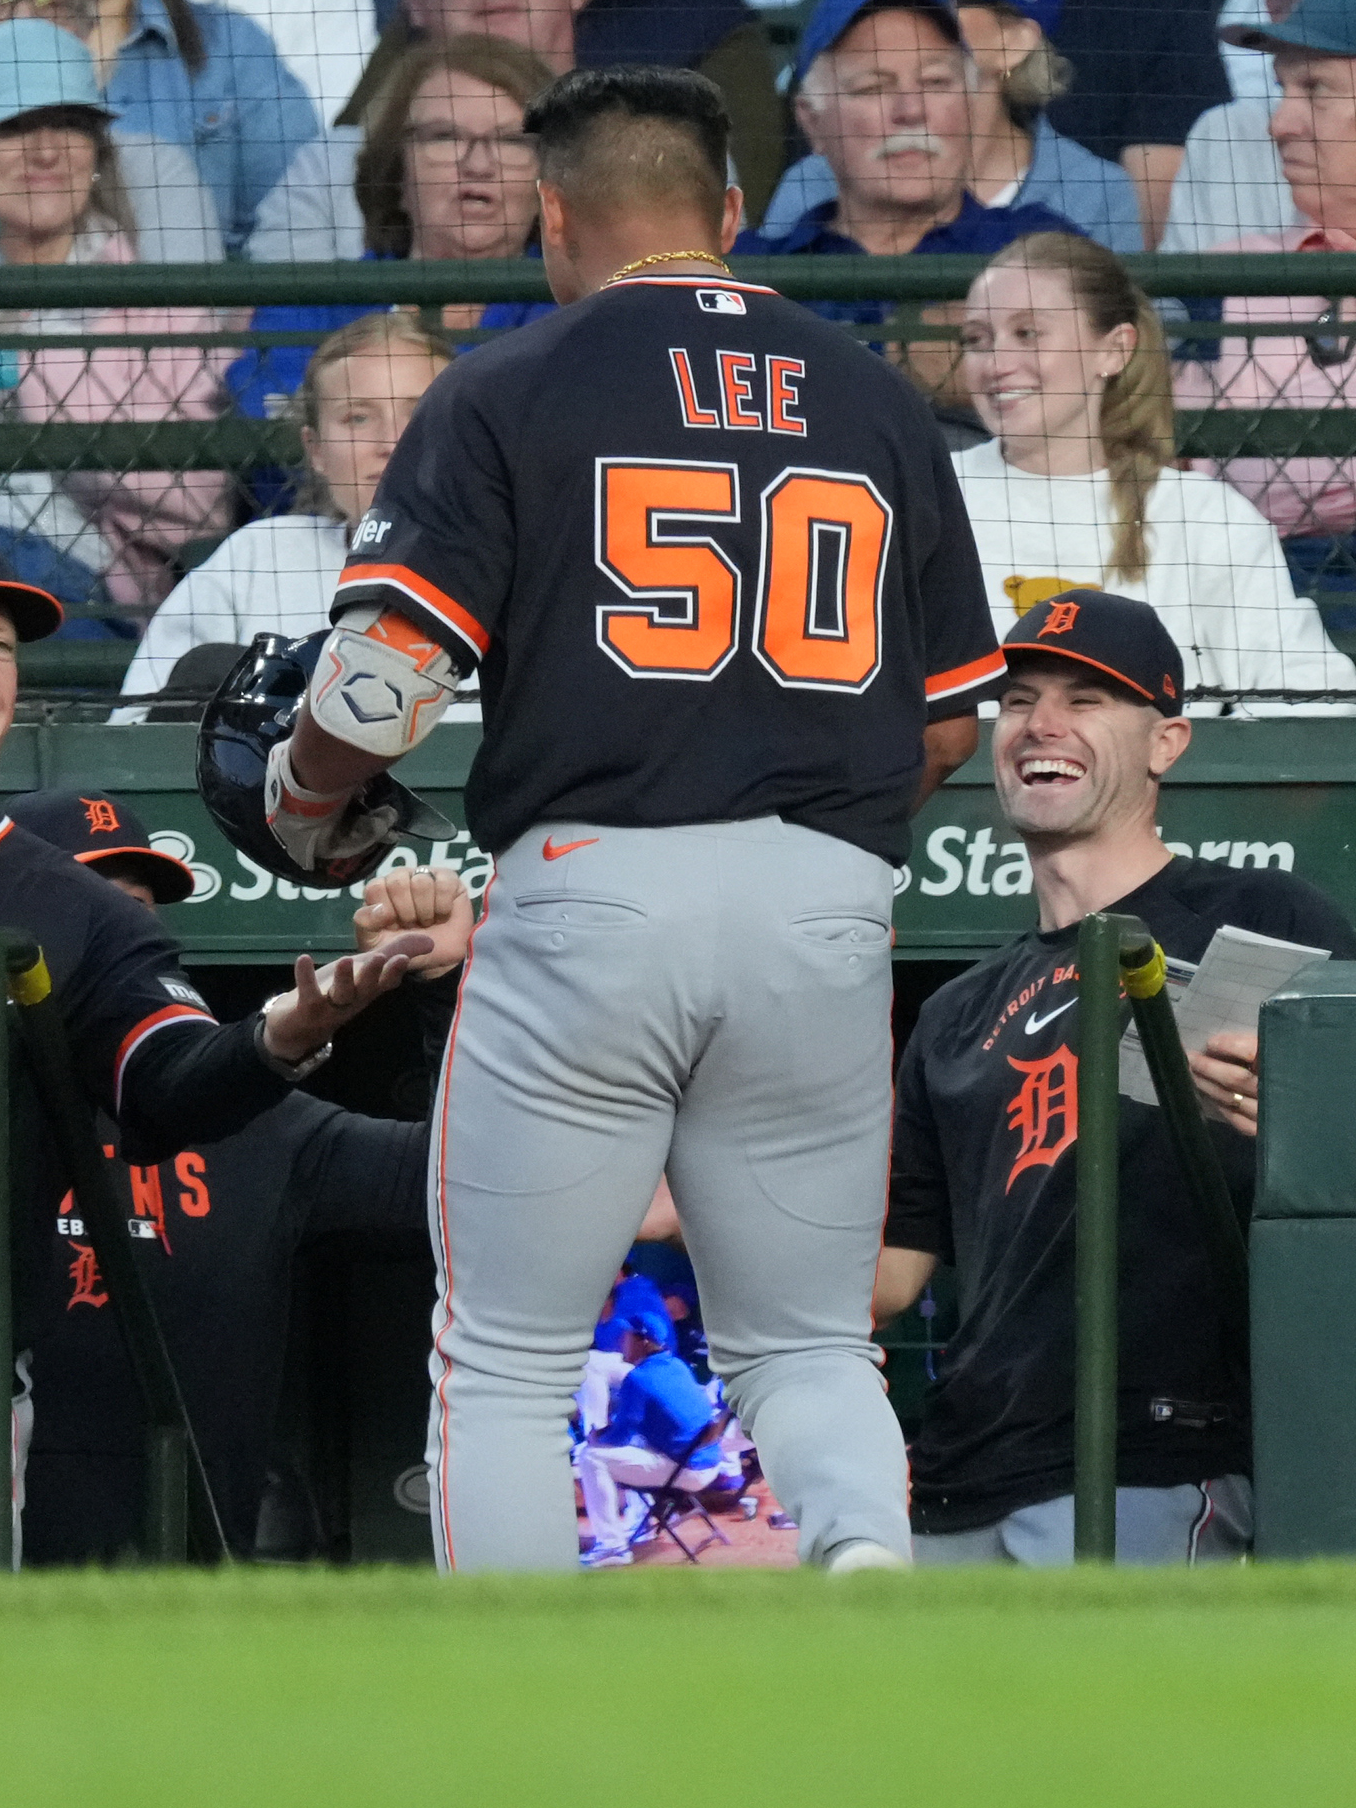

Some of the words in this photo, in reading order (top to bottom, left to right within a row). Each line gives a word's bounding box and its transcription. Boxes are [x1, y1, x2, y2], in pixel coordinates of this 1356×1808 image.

[668, 348, 807, 437] LEE
[595, 457, 893, 695] 50
[1037, 601, 1081, 639] D
[78, 798, 120, 835] D
[1005, 1042, 1079, 1195] D
